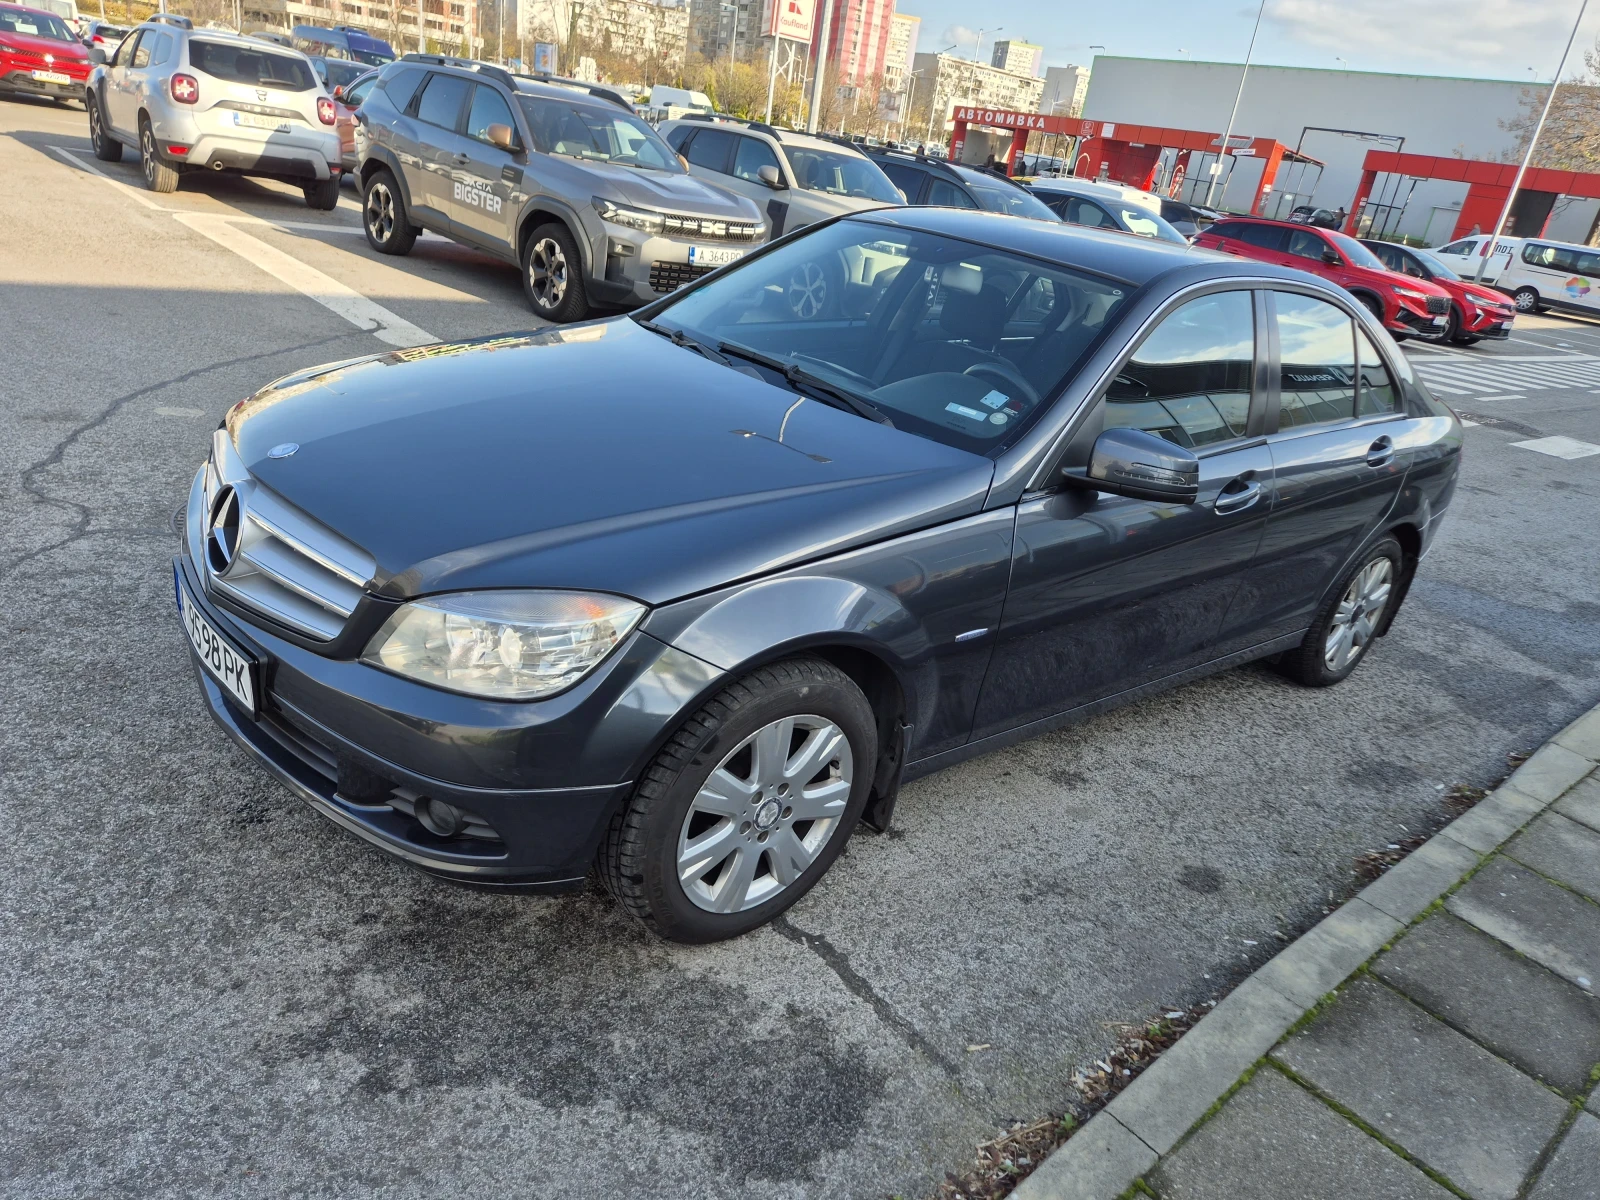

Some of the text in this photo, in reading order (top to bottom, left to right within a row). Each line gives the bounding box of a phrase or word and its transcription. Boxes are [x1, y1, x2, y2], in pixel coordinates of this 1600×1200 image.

[958, 108, 1045, 129] АВТОМИВКА
[454, 181, 502, 215] BIGSTER
[698, 249, 704, 261] A
